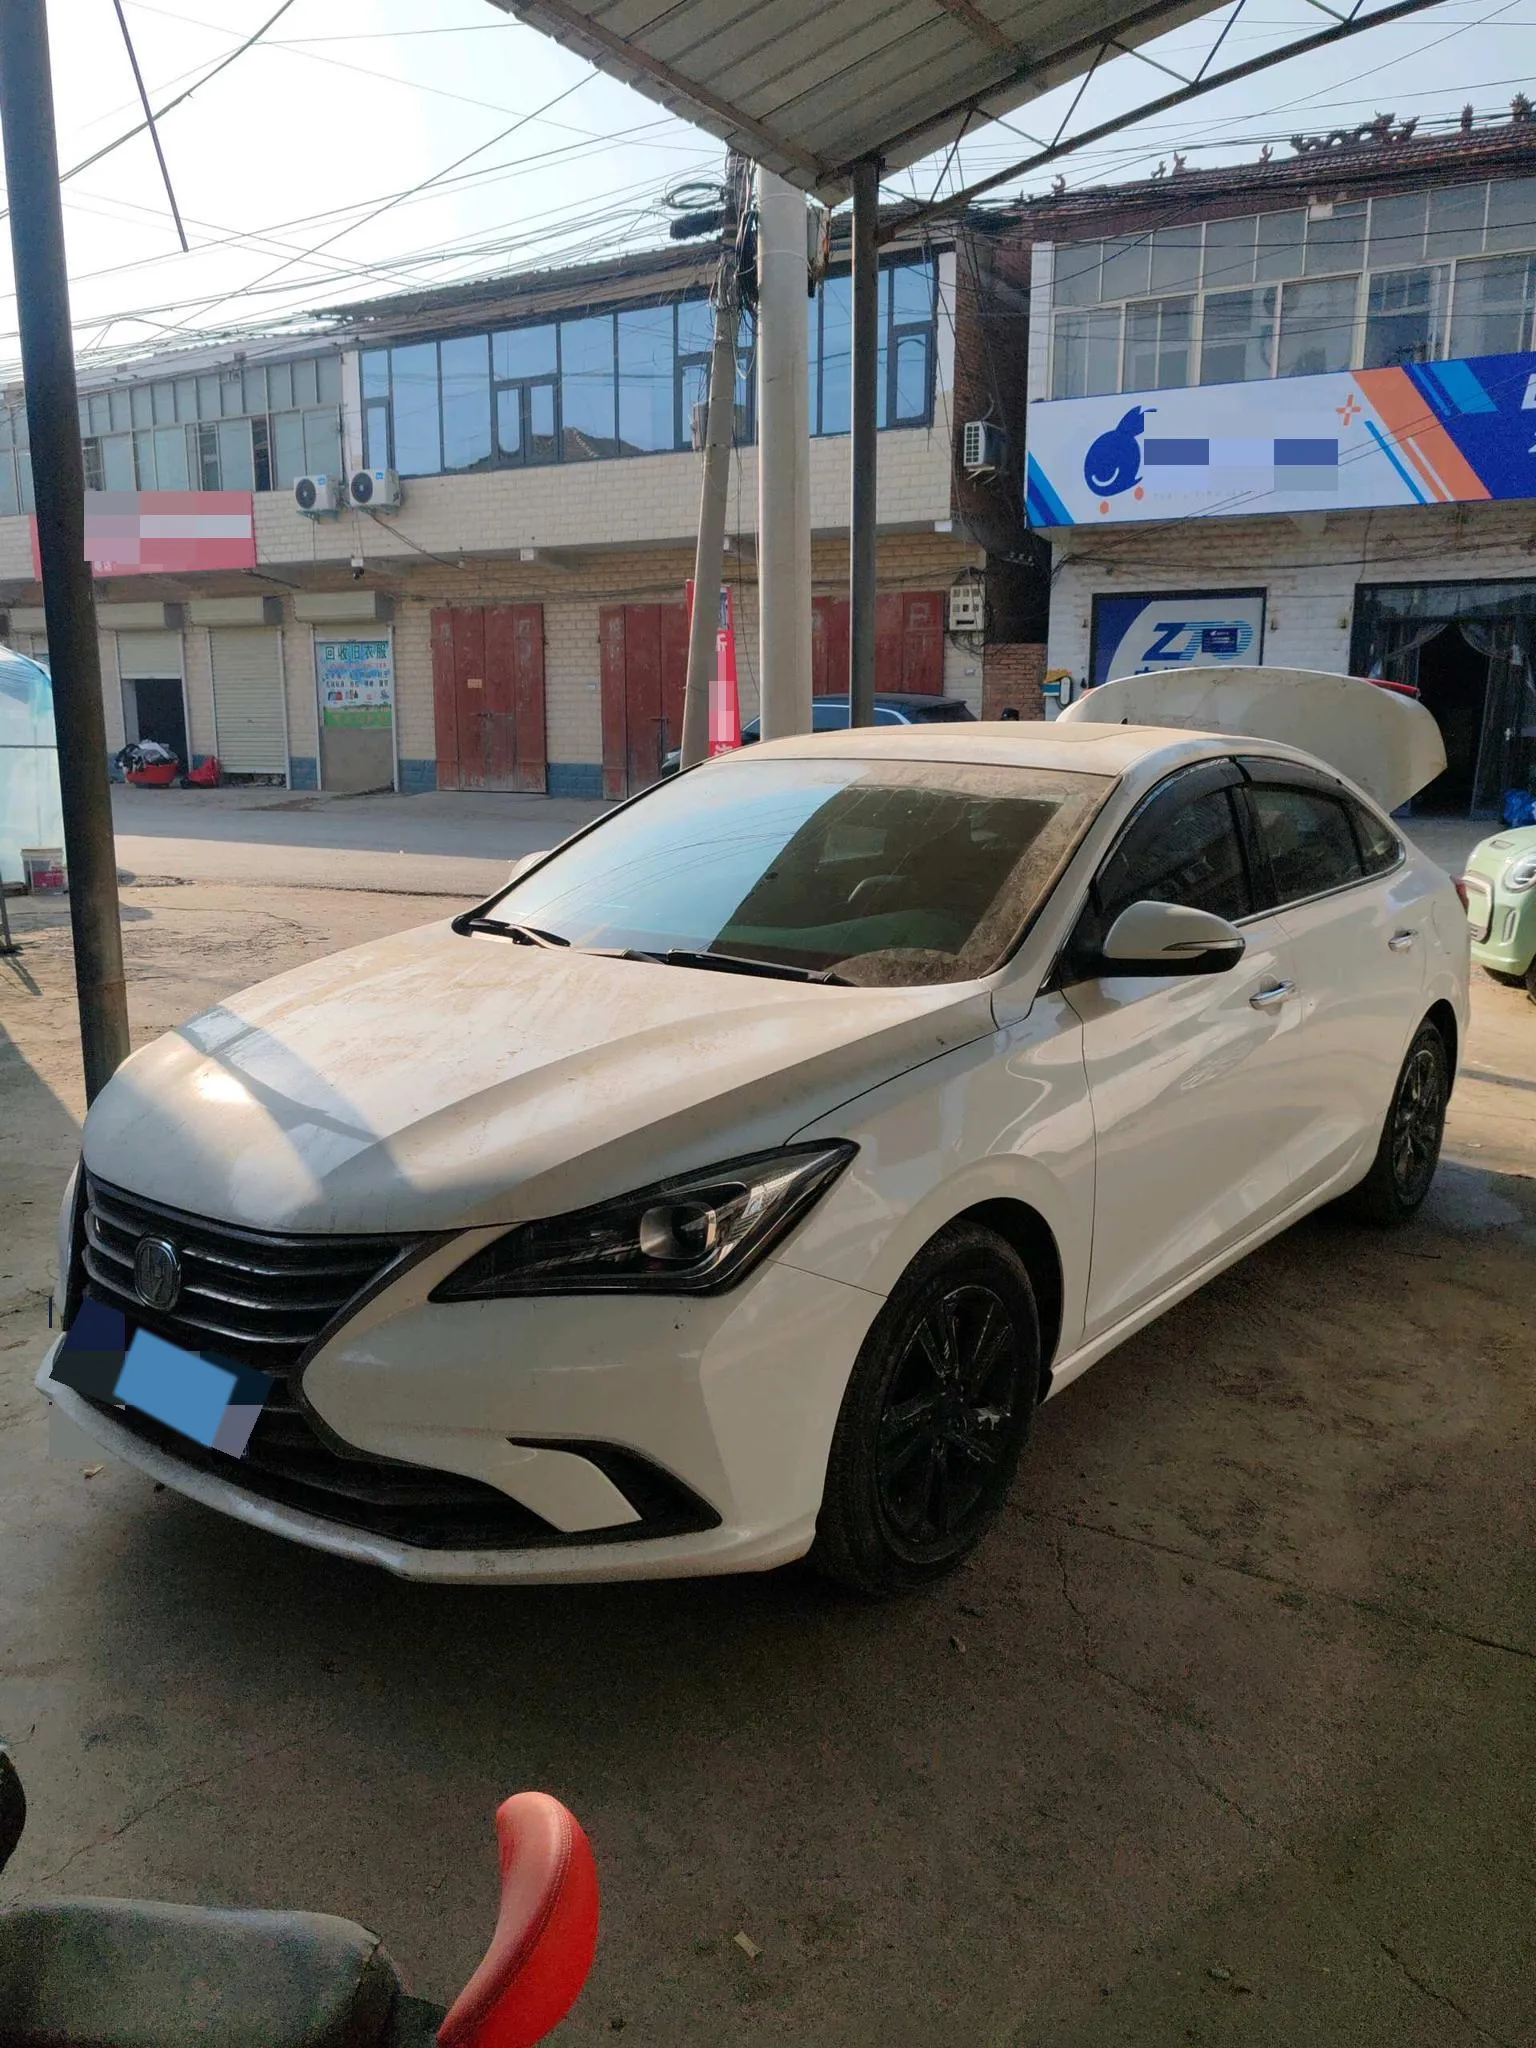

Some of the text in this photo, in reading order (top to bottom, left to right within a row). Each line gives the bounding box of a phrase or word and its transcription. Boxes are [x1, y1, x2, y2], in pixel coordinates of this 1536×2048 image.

[325, 643, 387, 661] 回收旧衣服
